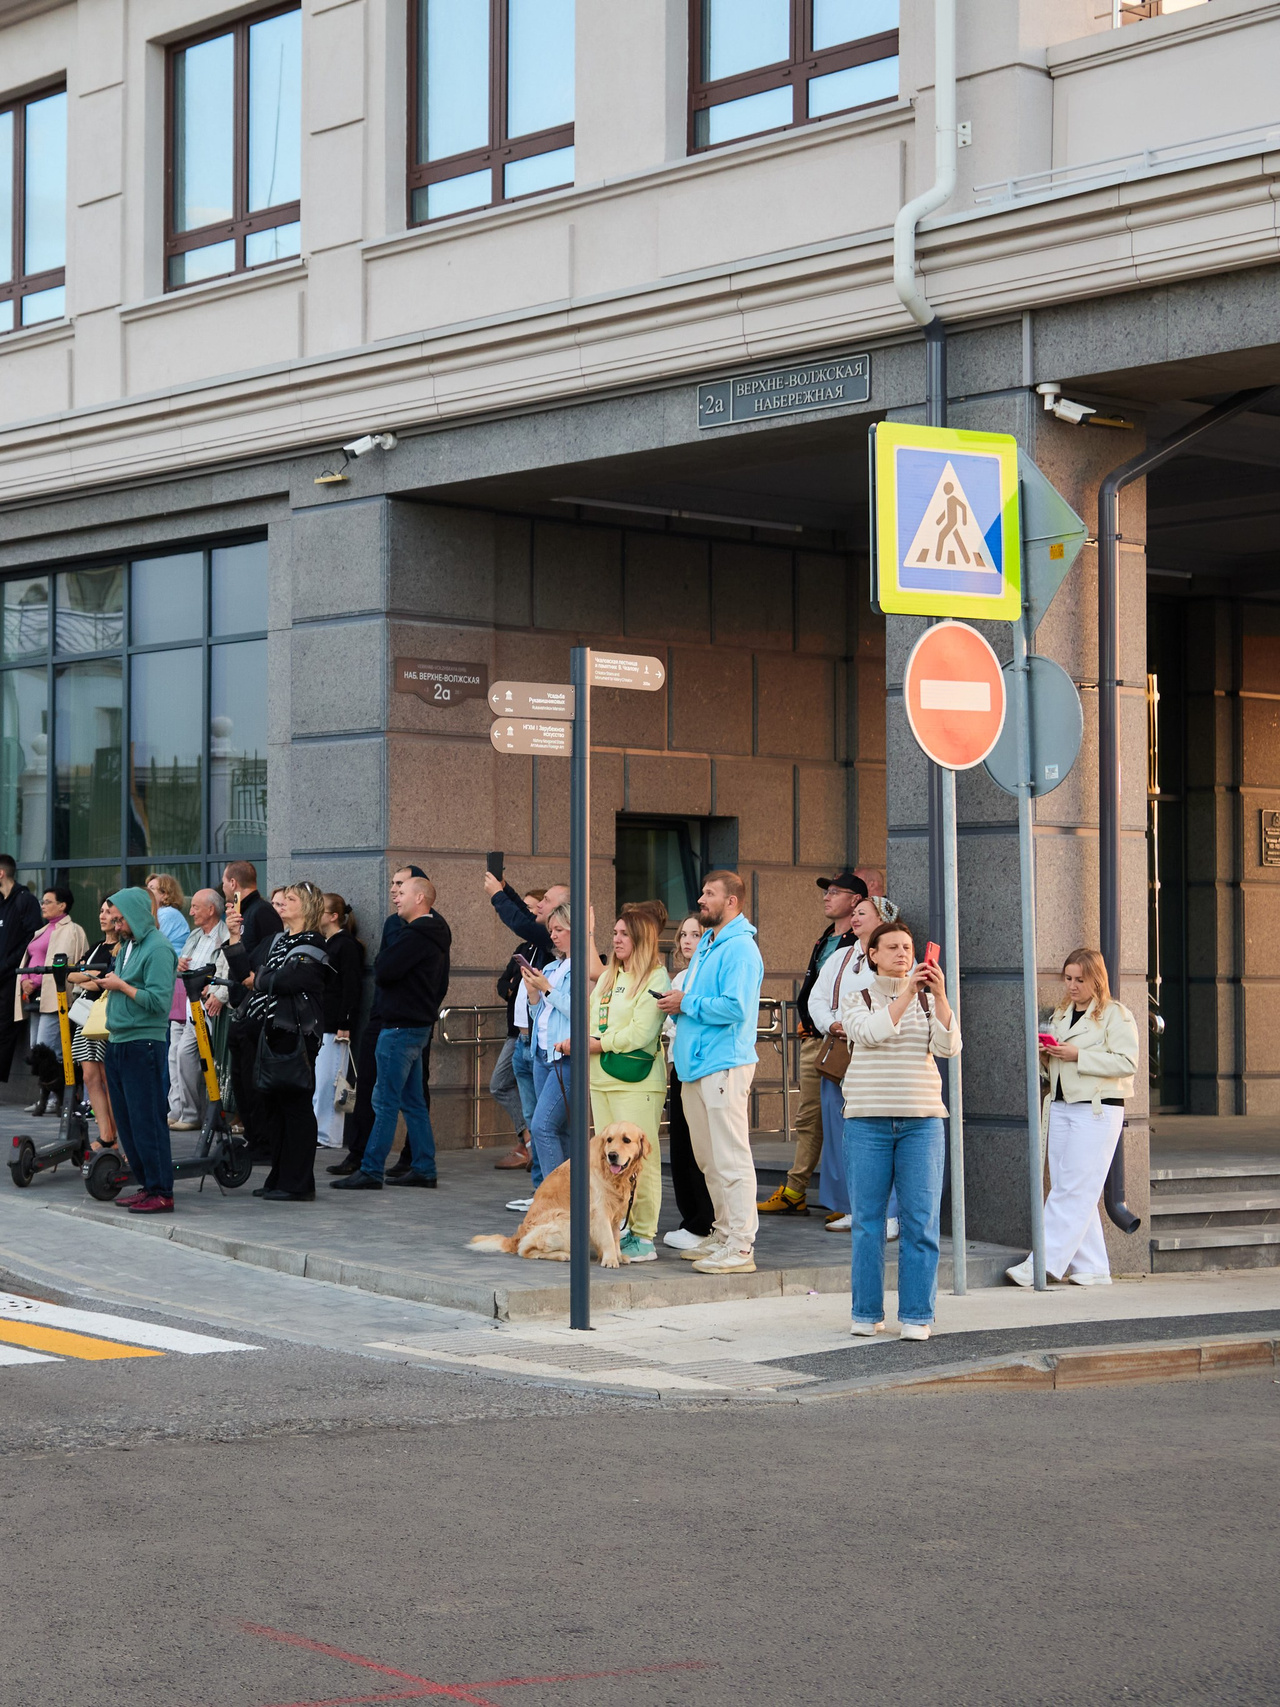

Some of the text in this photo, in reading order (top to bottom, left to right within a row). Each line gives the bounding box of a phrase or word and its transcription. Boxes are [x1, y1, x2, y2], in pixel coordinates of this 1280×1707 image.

[736, 362, 864, 397] ВЕРХНЕ-ВОЛЖСКАЯ
[704, 395, 724, 415] 2а
[754, 384, 844, 412] НАБЕРЕЖНАЯ
[419, 673, 480, 684] ВЕРХНЕ-ВОЛЖСКАЯ
[434, 683, 451, 700] 2а
